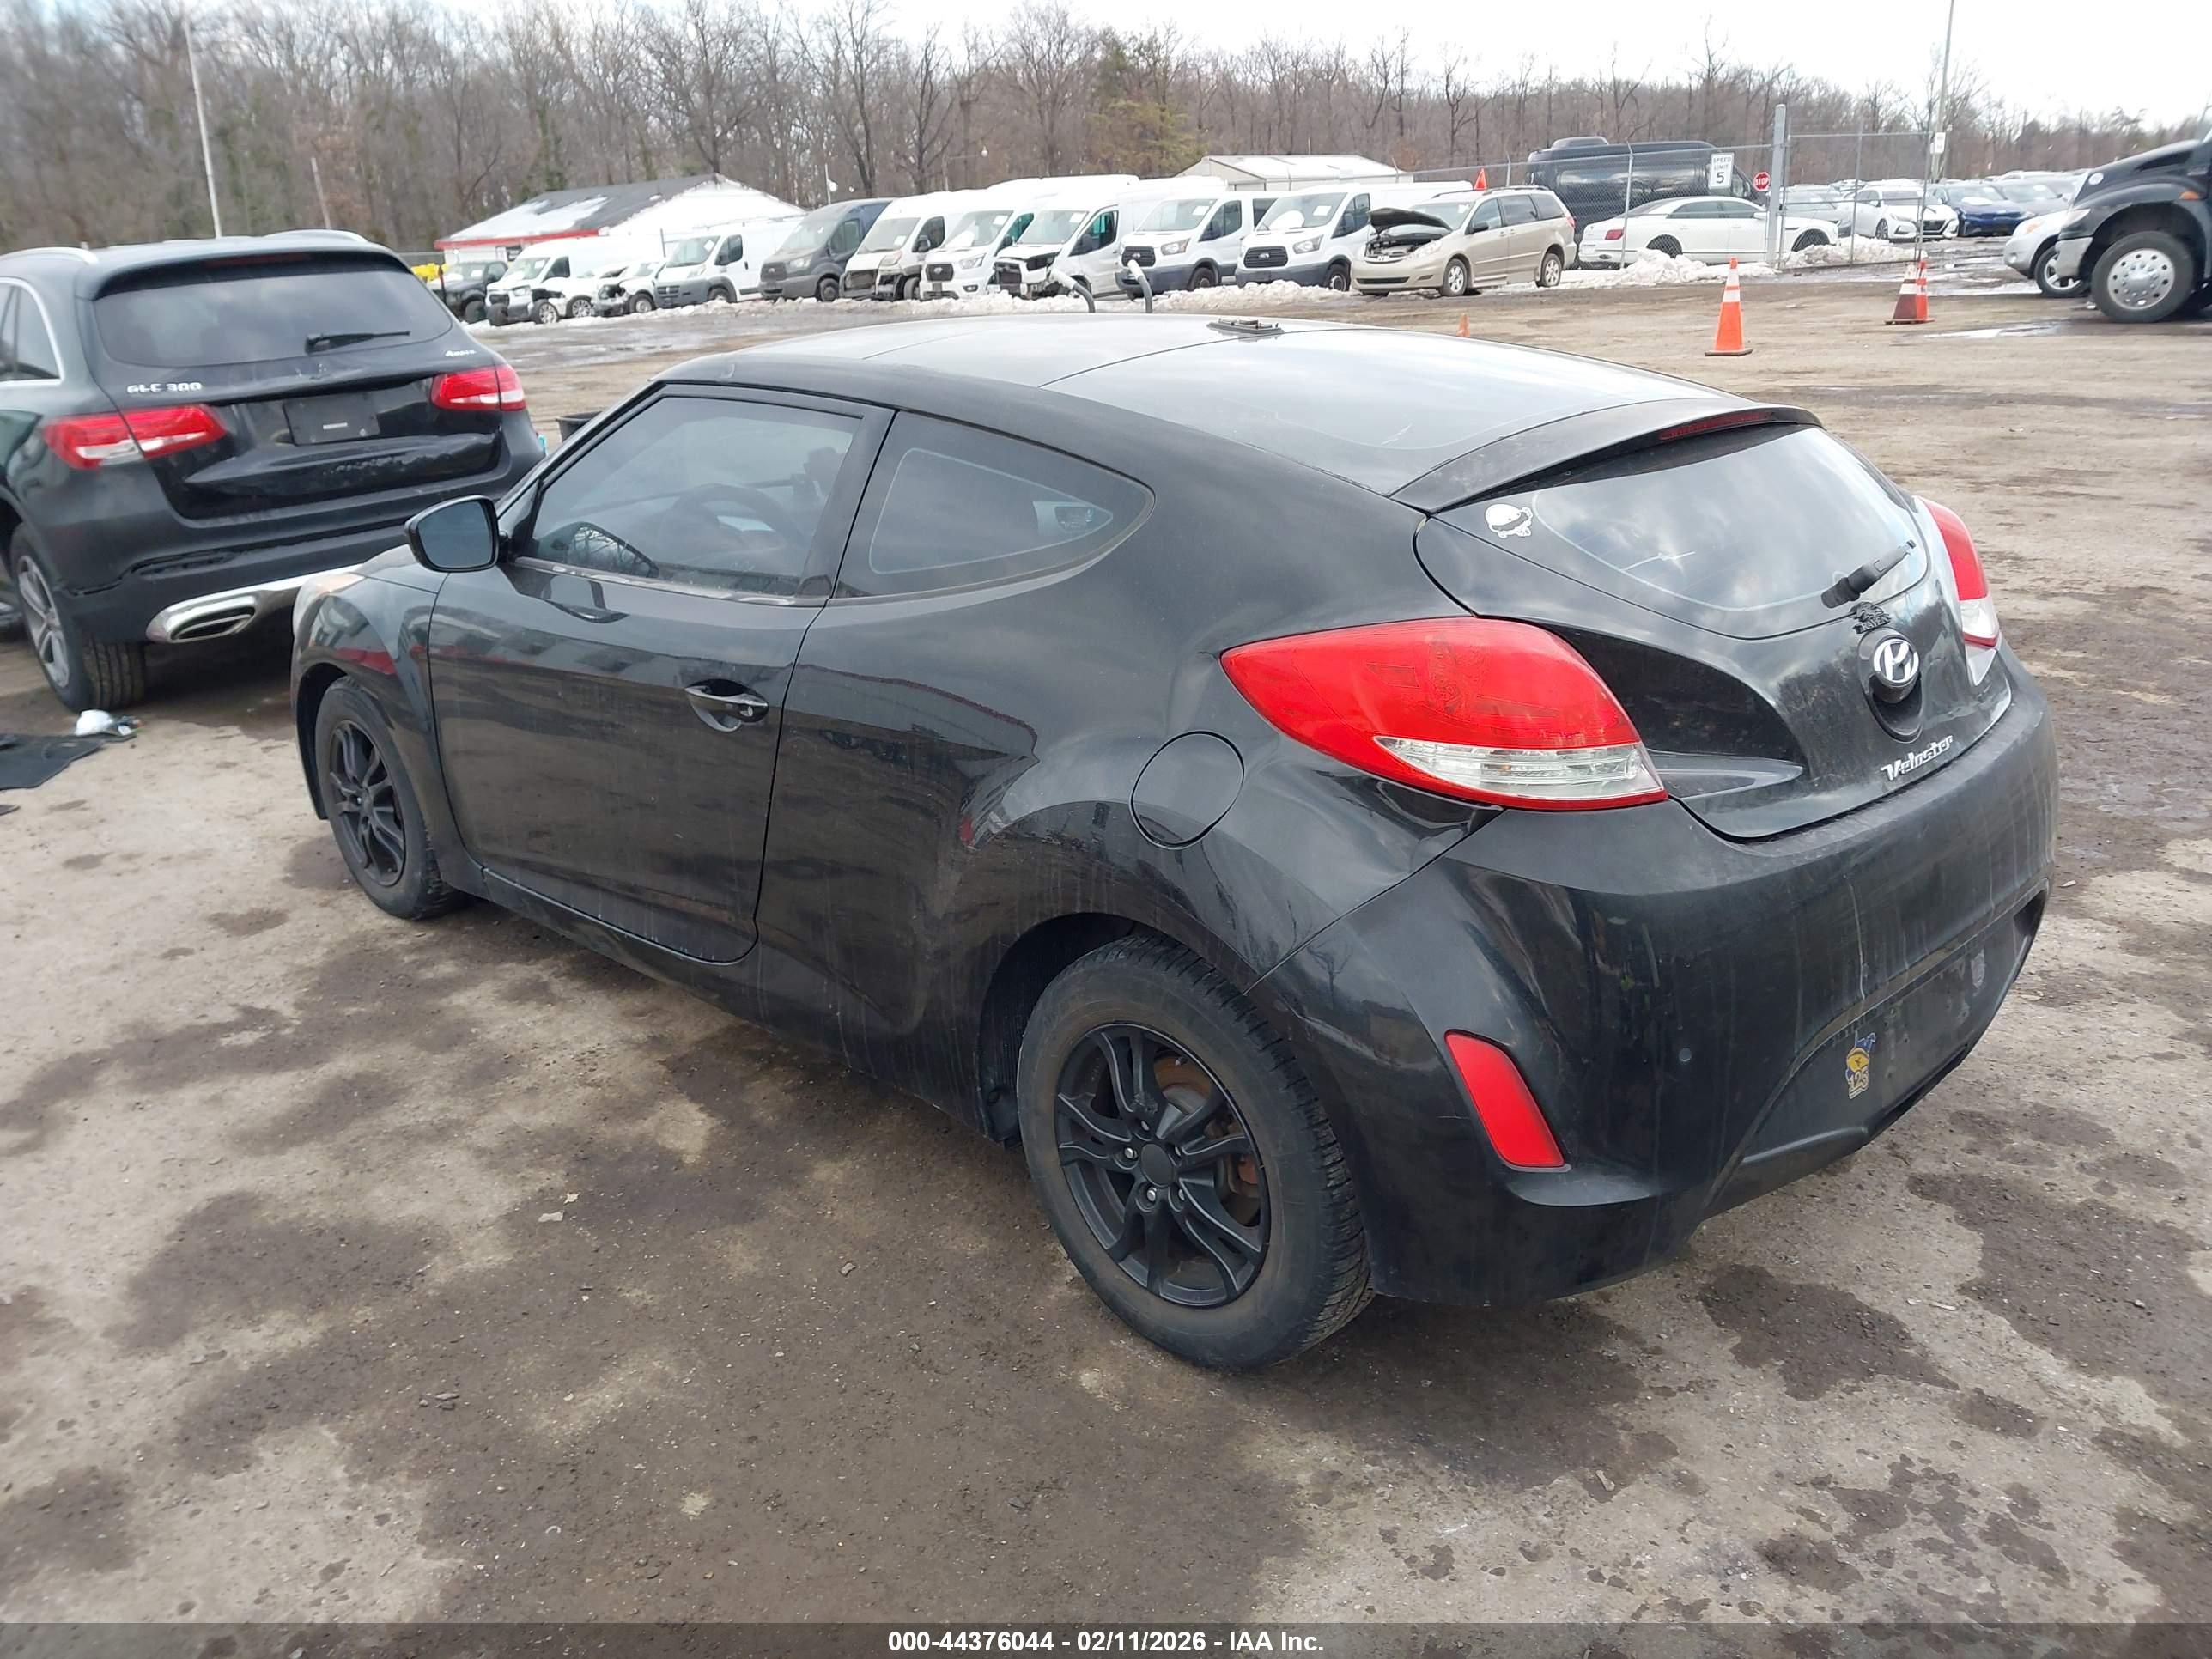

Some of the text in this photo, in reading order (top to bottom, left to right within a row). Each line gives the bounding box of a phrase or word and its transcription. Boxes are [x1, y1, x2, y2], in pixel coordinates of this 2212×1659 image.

[1716, 172, 1725, 184] 5
[1755, 177, 1770, 186] STOP
[126, 381, 203, 394] GLC 300
[1880, 735, 1954, 781] Veloster
